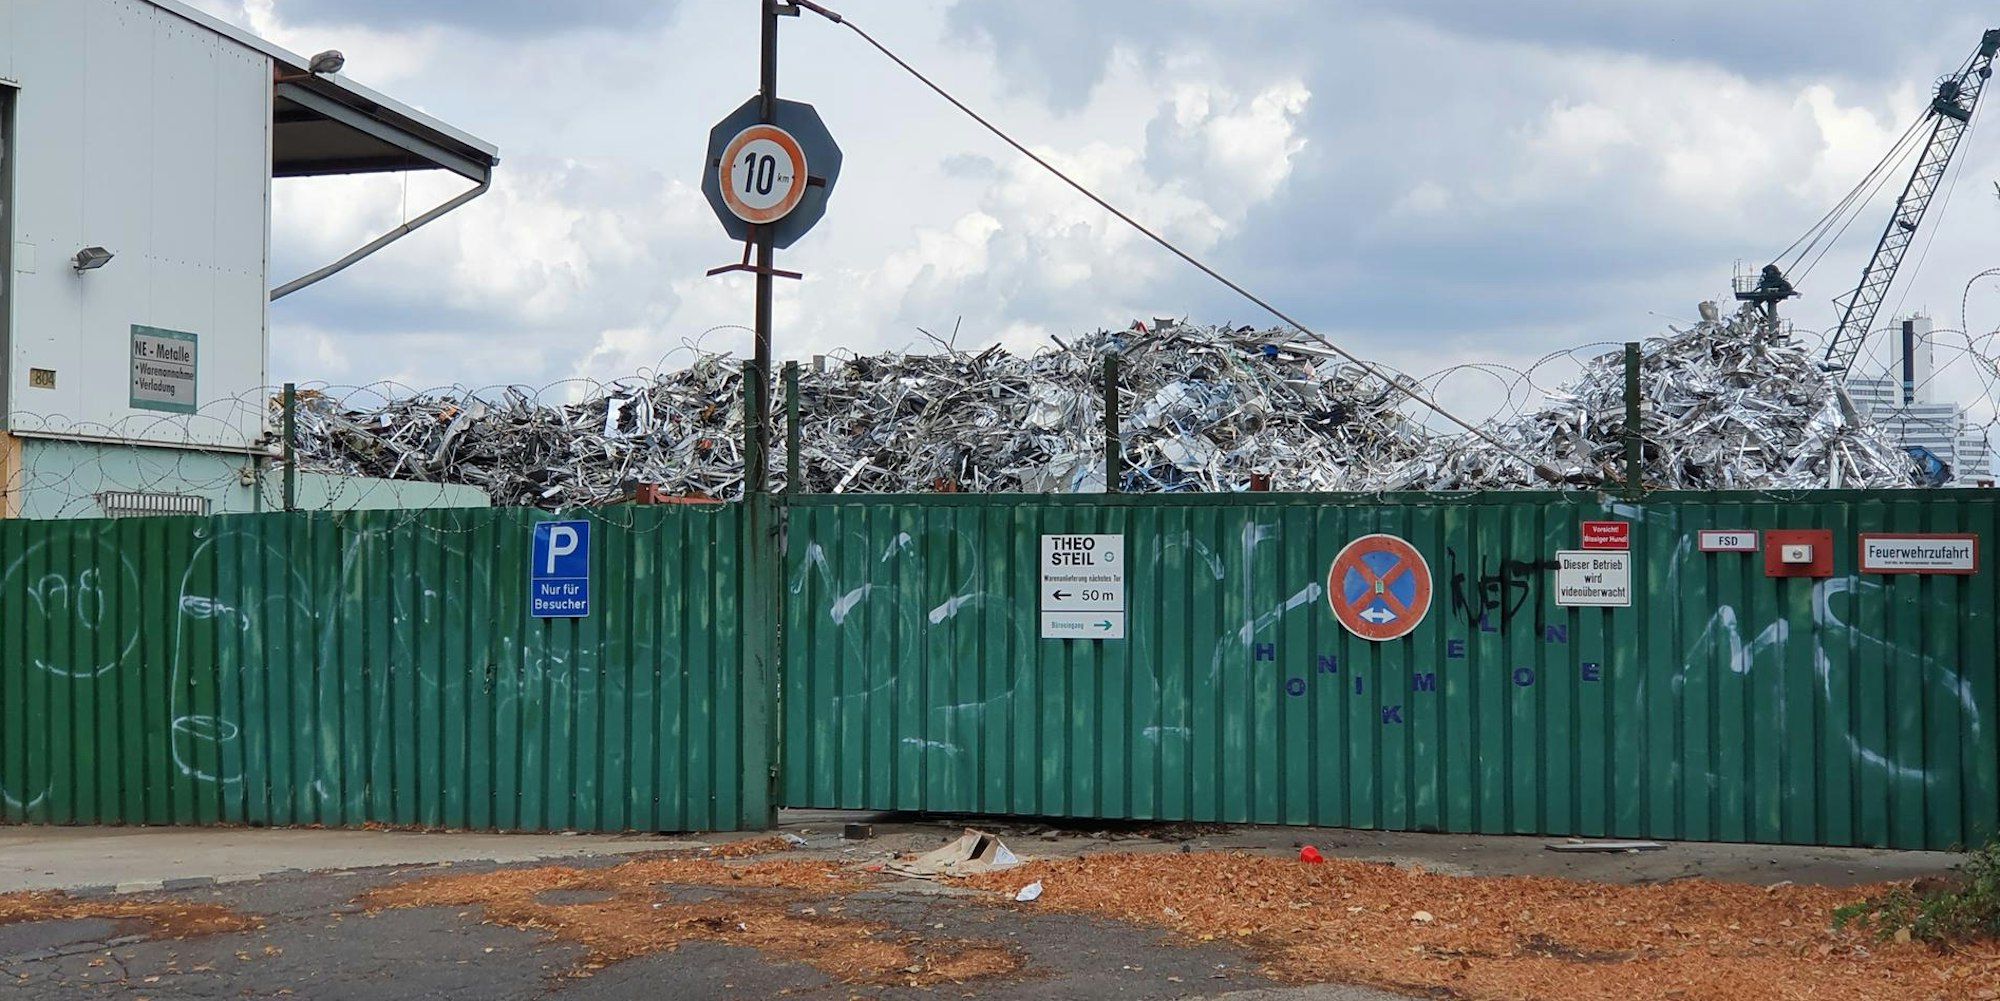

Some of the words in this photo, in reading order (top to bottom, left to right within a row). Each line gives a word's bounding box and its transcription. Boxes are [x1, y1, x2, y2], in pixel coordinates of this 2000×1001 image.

[744, 152, 776, 195] 10
[135, 341, 147, 356] NE
[156, 344, 190, 362] Metalle
[139, 362, 194, 380] Warenannahme
[139, 378, 175, 396] Verladung
[1051, 537, 1095, 550] THEO
[1718, 536, 1738, 546] FSD
[547, 526, 578, 573] P
[1869, 545, 1969, 559] Feuerwehrzufahrt
[1051, 552, 1095, 566] STEIL
[1563, 559, 1590, 570] Dieser
[1593, 559, 1623, 570] Betrieb
[1584, 573, 1602, 583] wird
[541, 584, 561, 595] Nur
[563, 584, 580, 595] für
[1082, 589, 1099, 601] 50
[1102, 592, 1114, 601] m
[1561, 586, 1626, 598] videoüberwacht
[534, 598, 587, 610] Besucher
